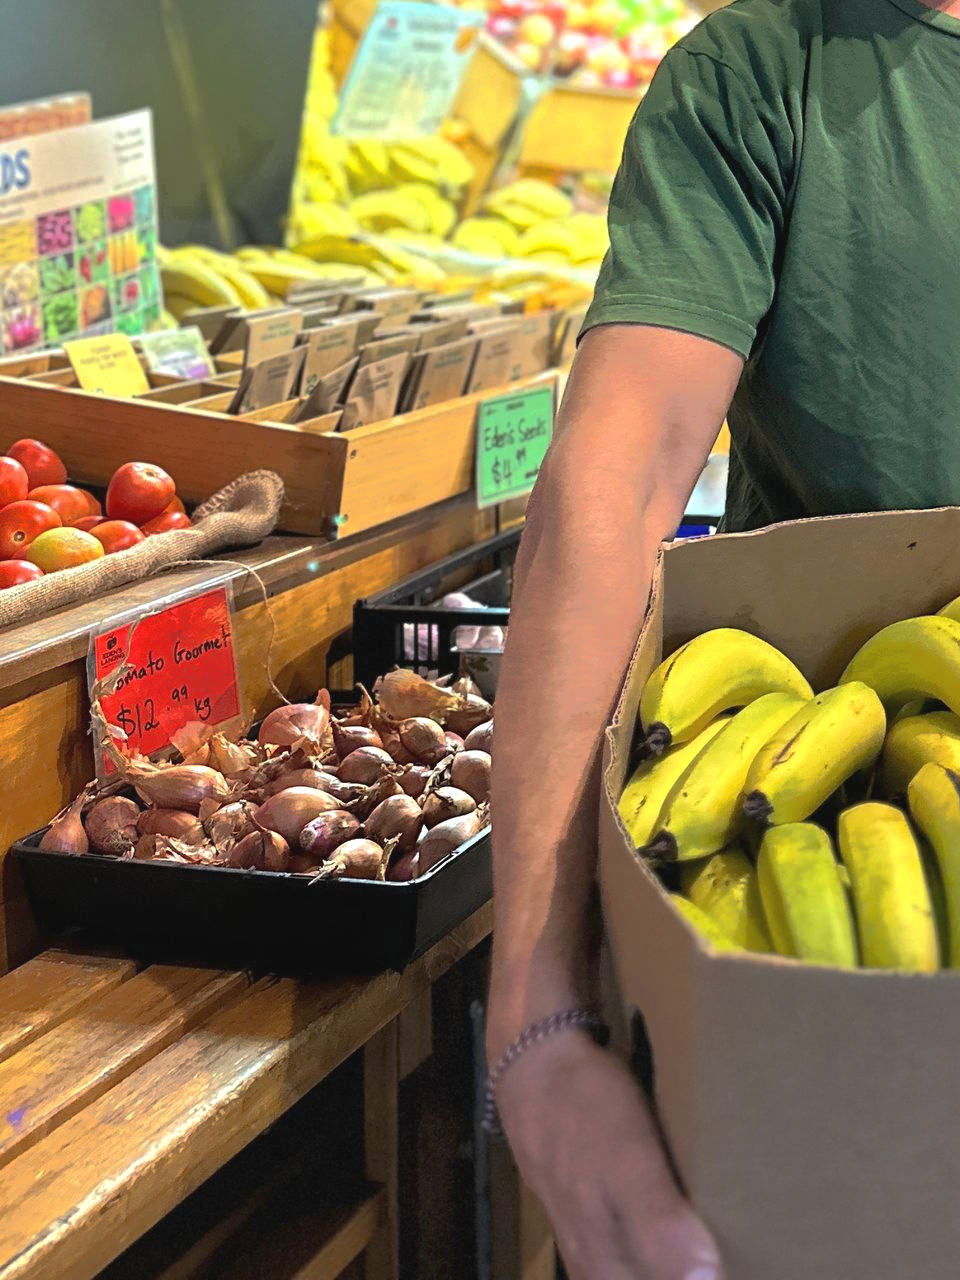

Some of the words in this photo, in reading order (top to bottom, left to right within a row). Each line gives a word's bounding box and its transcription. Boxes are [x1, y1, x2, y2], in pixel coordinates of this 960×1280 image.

[101, 653, 126, 666] LANDING
[115, 650, 165, 691] omato
[174, 624, 232, 665] Gourmet
[194, 696, 213, 721] kg
